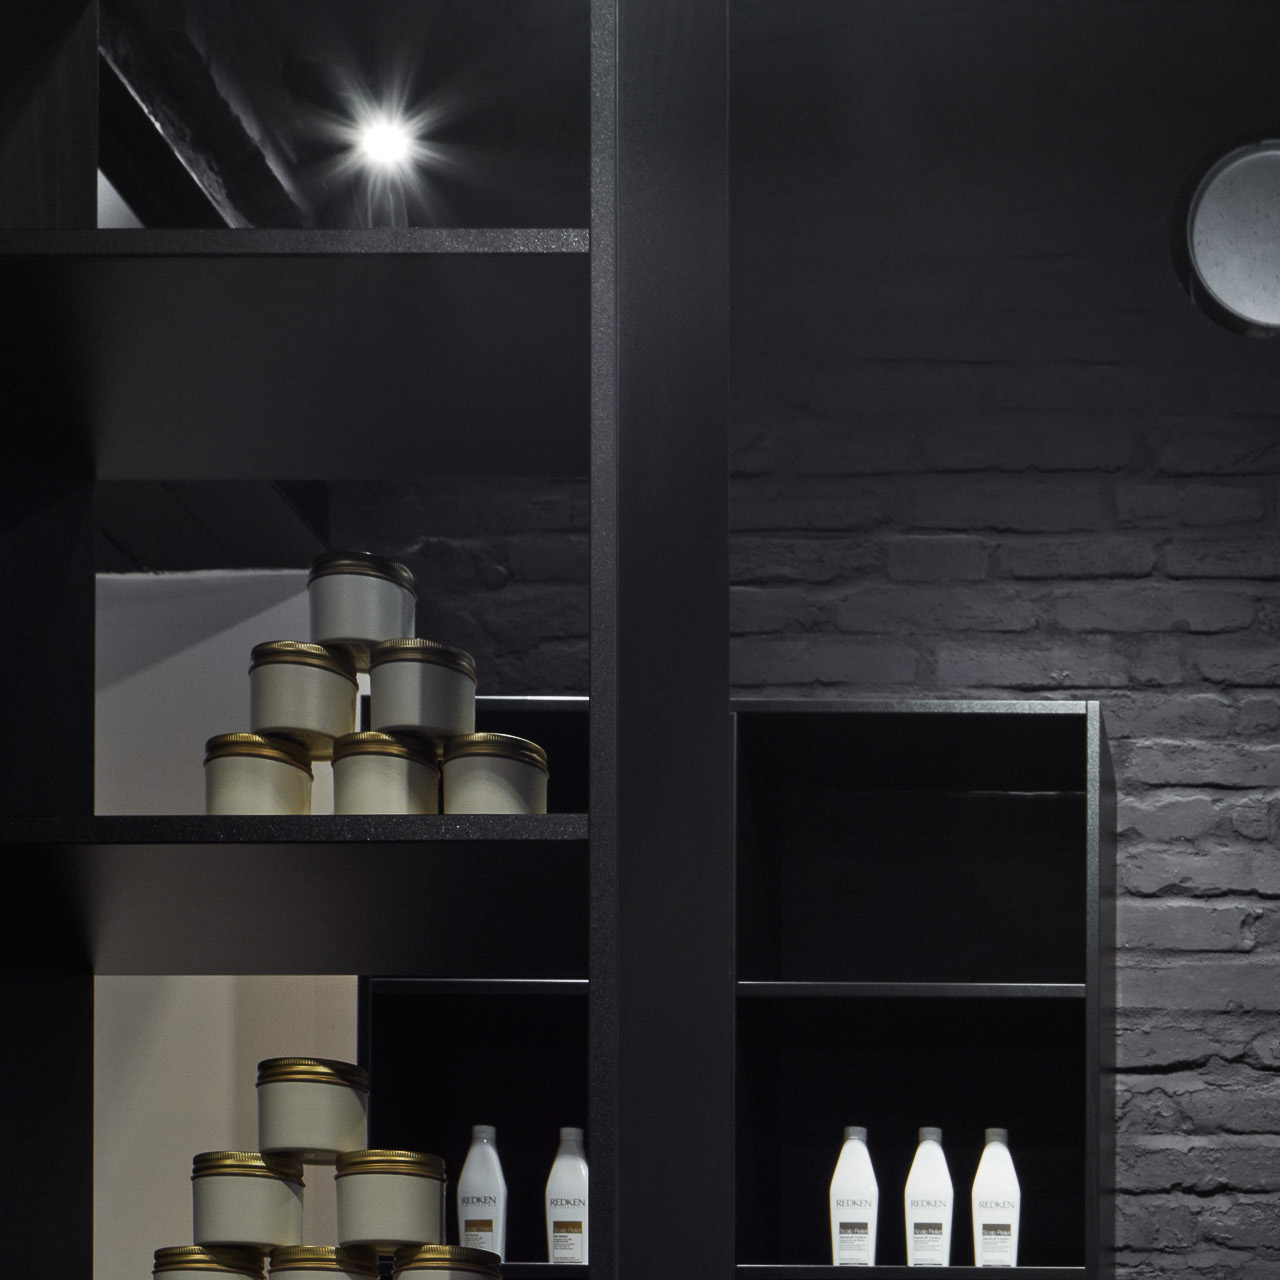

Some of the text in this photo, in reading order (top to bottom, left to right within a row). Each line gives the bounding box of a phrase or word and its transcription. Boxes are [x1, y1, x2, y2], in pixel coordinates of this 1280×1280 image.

[461, 1196, 496, 1204] REDKEN
[550, 1198, 585, 1206] REDKEN
[836, 1199, 872, 1207] REDKEN
[911, 1200, 946, 1208] REDKEN
[979, 1200, 1015, 1208] REDKEN
